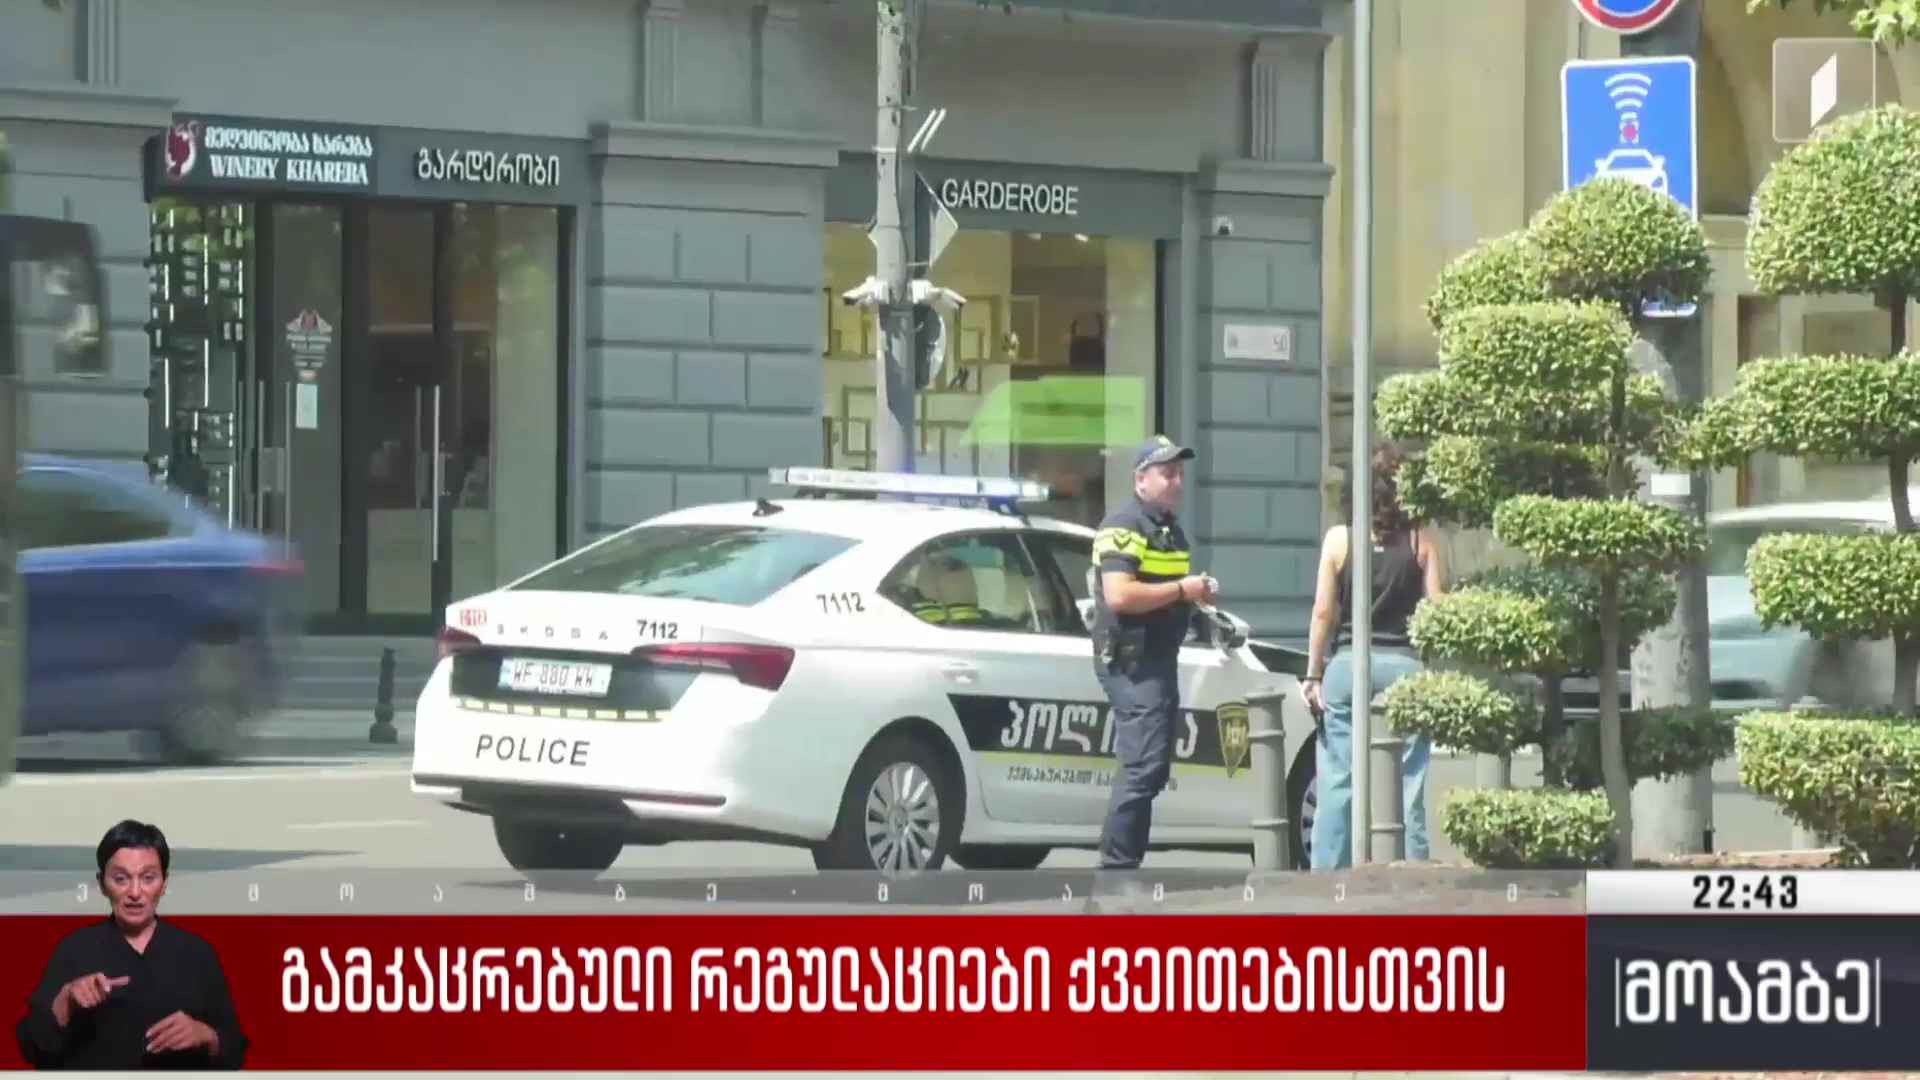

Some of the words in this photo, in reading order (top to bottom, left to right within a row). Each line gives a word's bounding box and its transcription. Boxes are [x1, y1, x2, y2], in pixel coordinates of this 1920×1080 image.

[312, 133, 373, 157] ხარება
[210, 154, 279, 180] WINERY
[286, 158, 368, 185] KHAREBA
[418, 147, 560, 186] გარდერობი
[942, 178, 1079, 215] GARDEROBE
[816, 592, 865, 614] 7112
[637, 619, 678, 640] 7112
[1001, 700, 1198, 758] პოლია
[475, 734, 591, 766] POLICE
